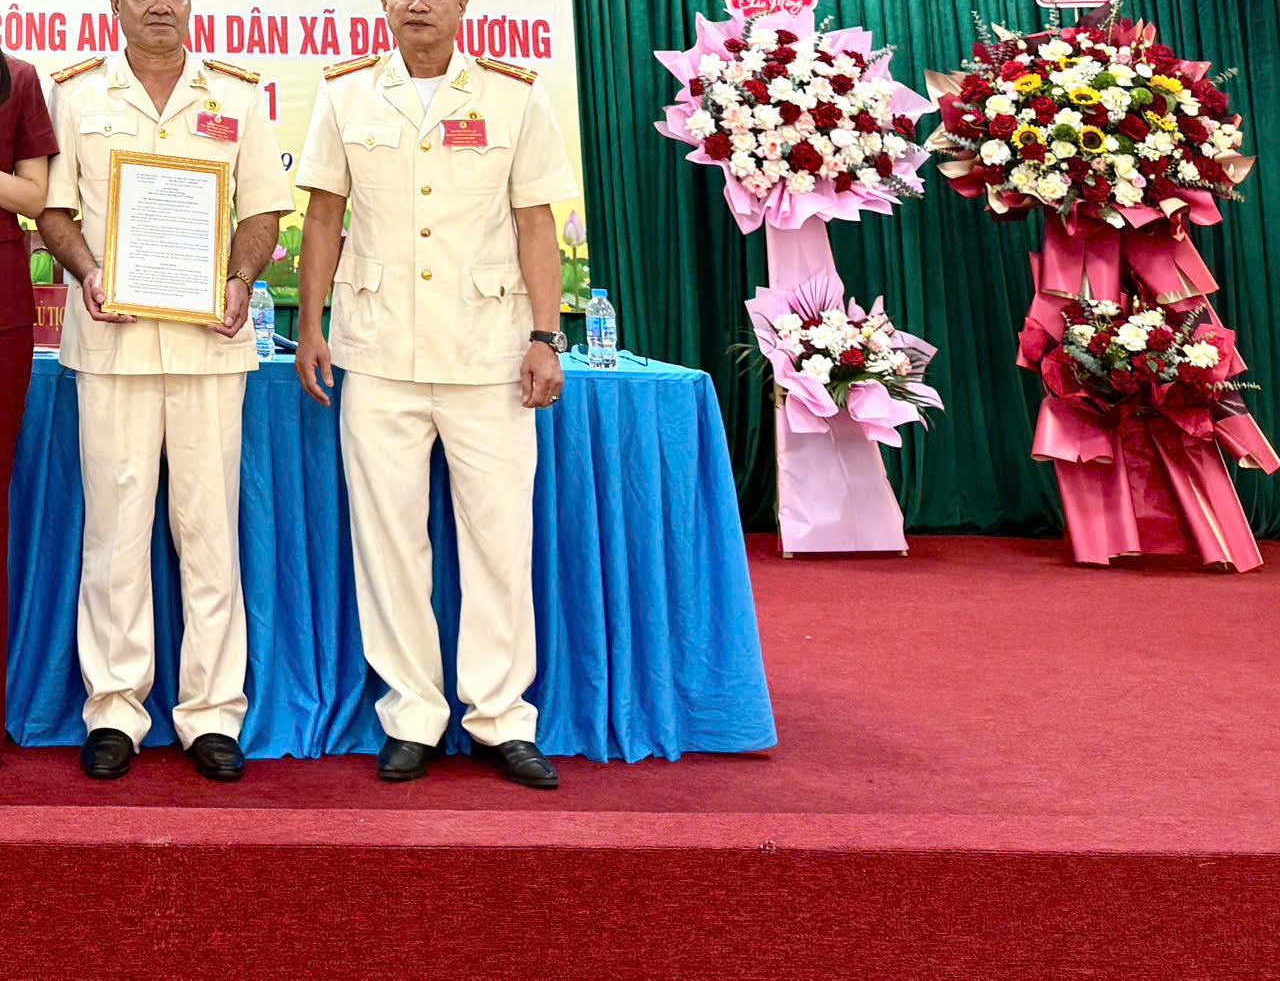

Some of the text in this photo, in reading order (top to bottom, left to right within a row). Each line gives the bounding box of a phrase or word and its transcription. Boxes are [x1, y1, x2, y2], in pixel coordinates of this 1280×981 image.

[77, 13, 119, 51] AN
[226, 7, 289, 55] DÂN
[299, 8, 341, 55] XÃ
